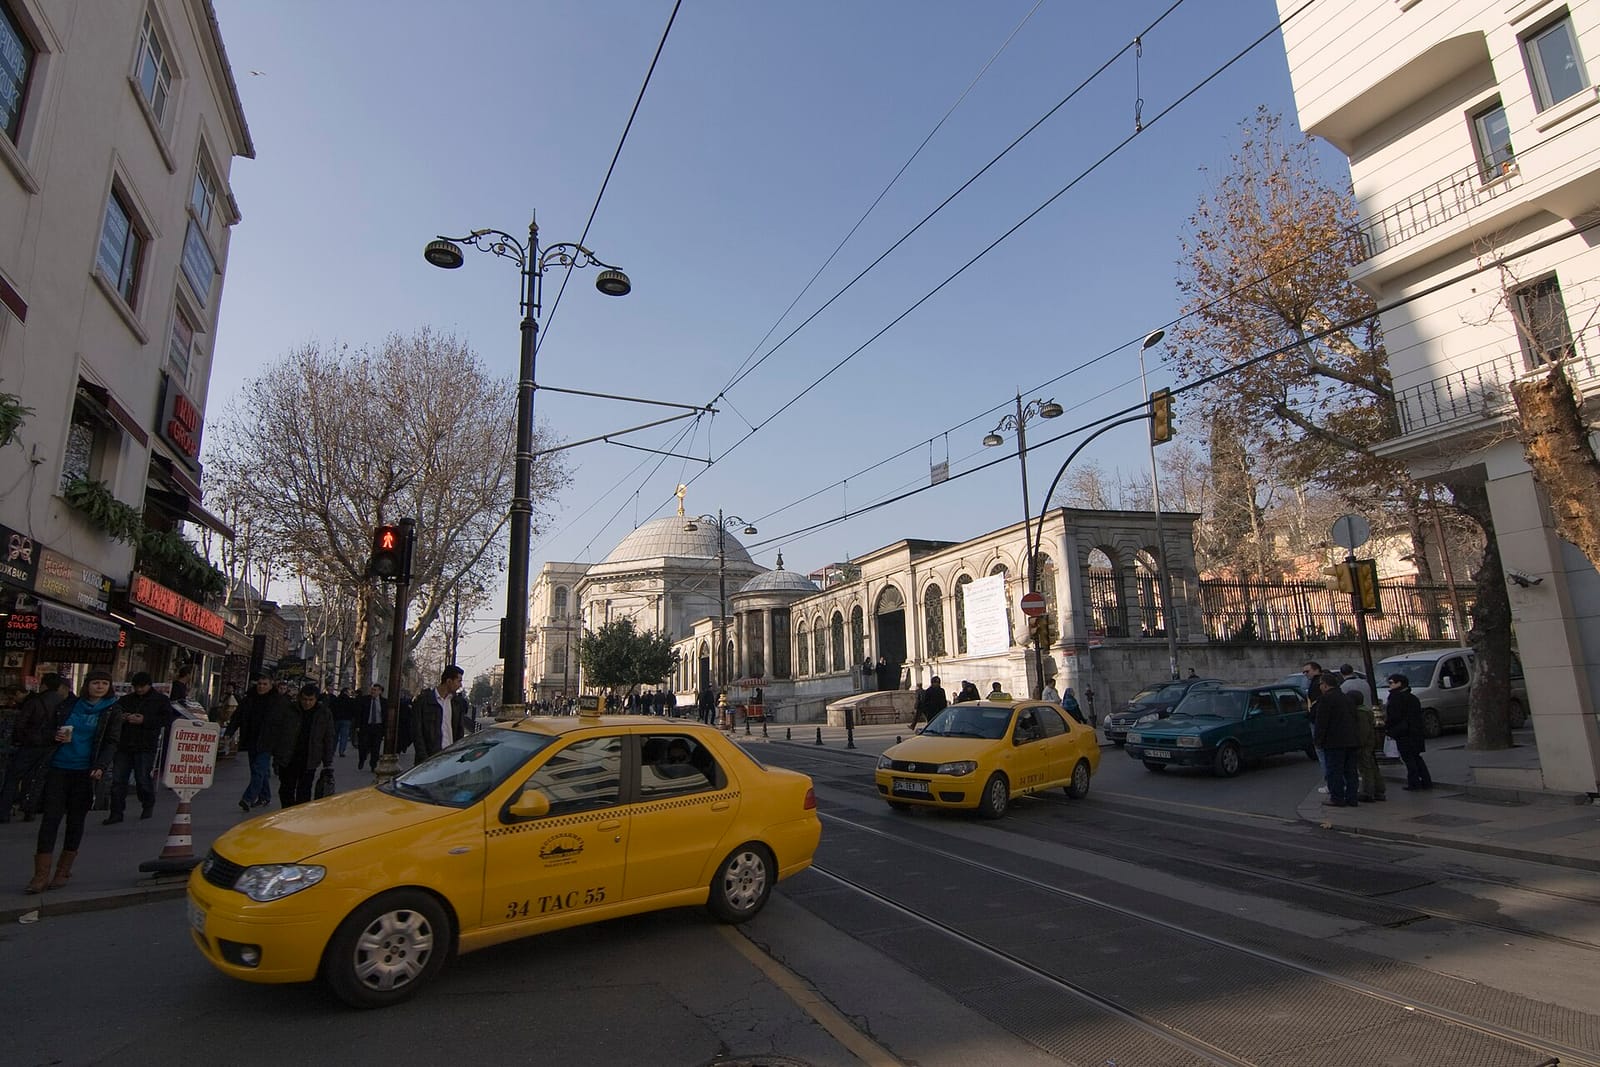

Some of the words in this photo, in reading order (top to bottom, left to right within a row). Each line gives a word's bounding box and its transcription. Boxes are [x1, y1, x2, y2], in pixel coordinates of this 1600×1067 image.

[11, 614, 38, 622] POST
[7, 621, 38, 630] STAMPS
[175, 729, 200, 741] LÜTFEN
[200, 732, 217, 743] PARK
[180, 753, 204, 763] BURASI
[505, 900, 530, 919] 34
[538, 890, 579, 914] TAC
[584, 886, 606, 905] 55
